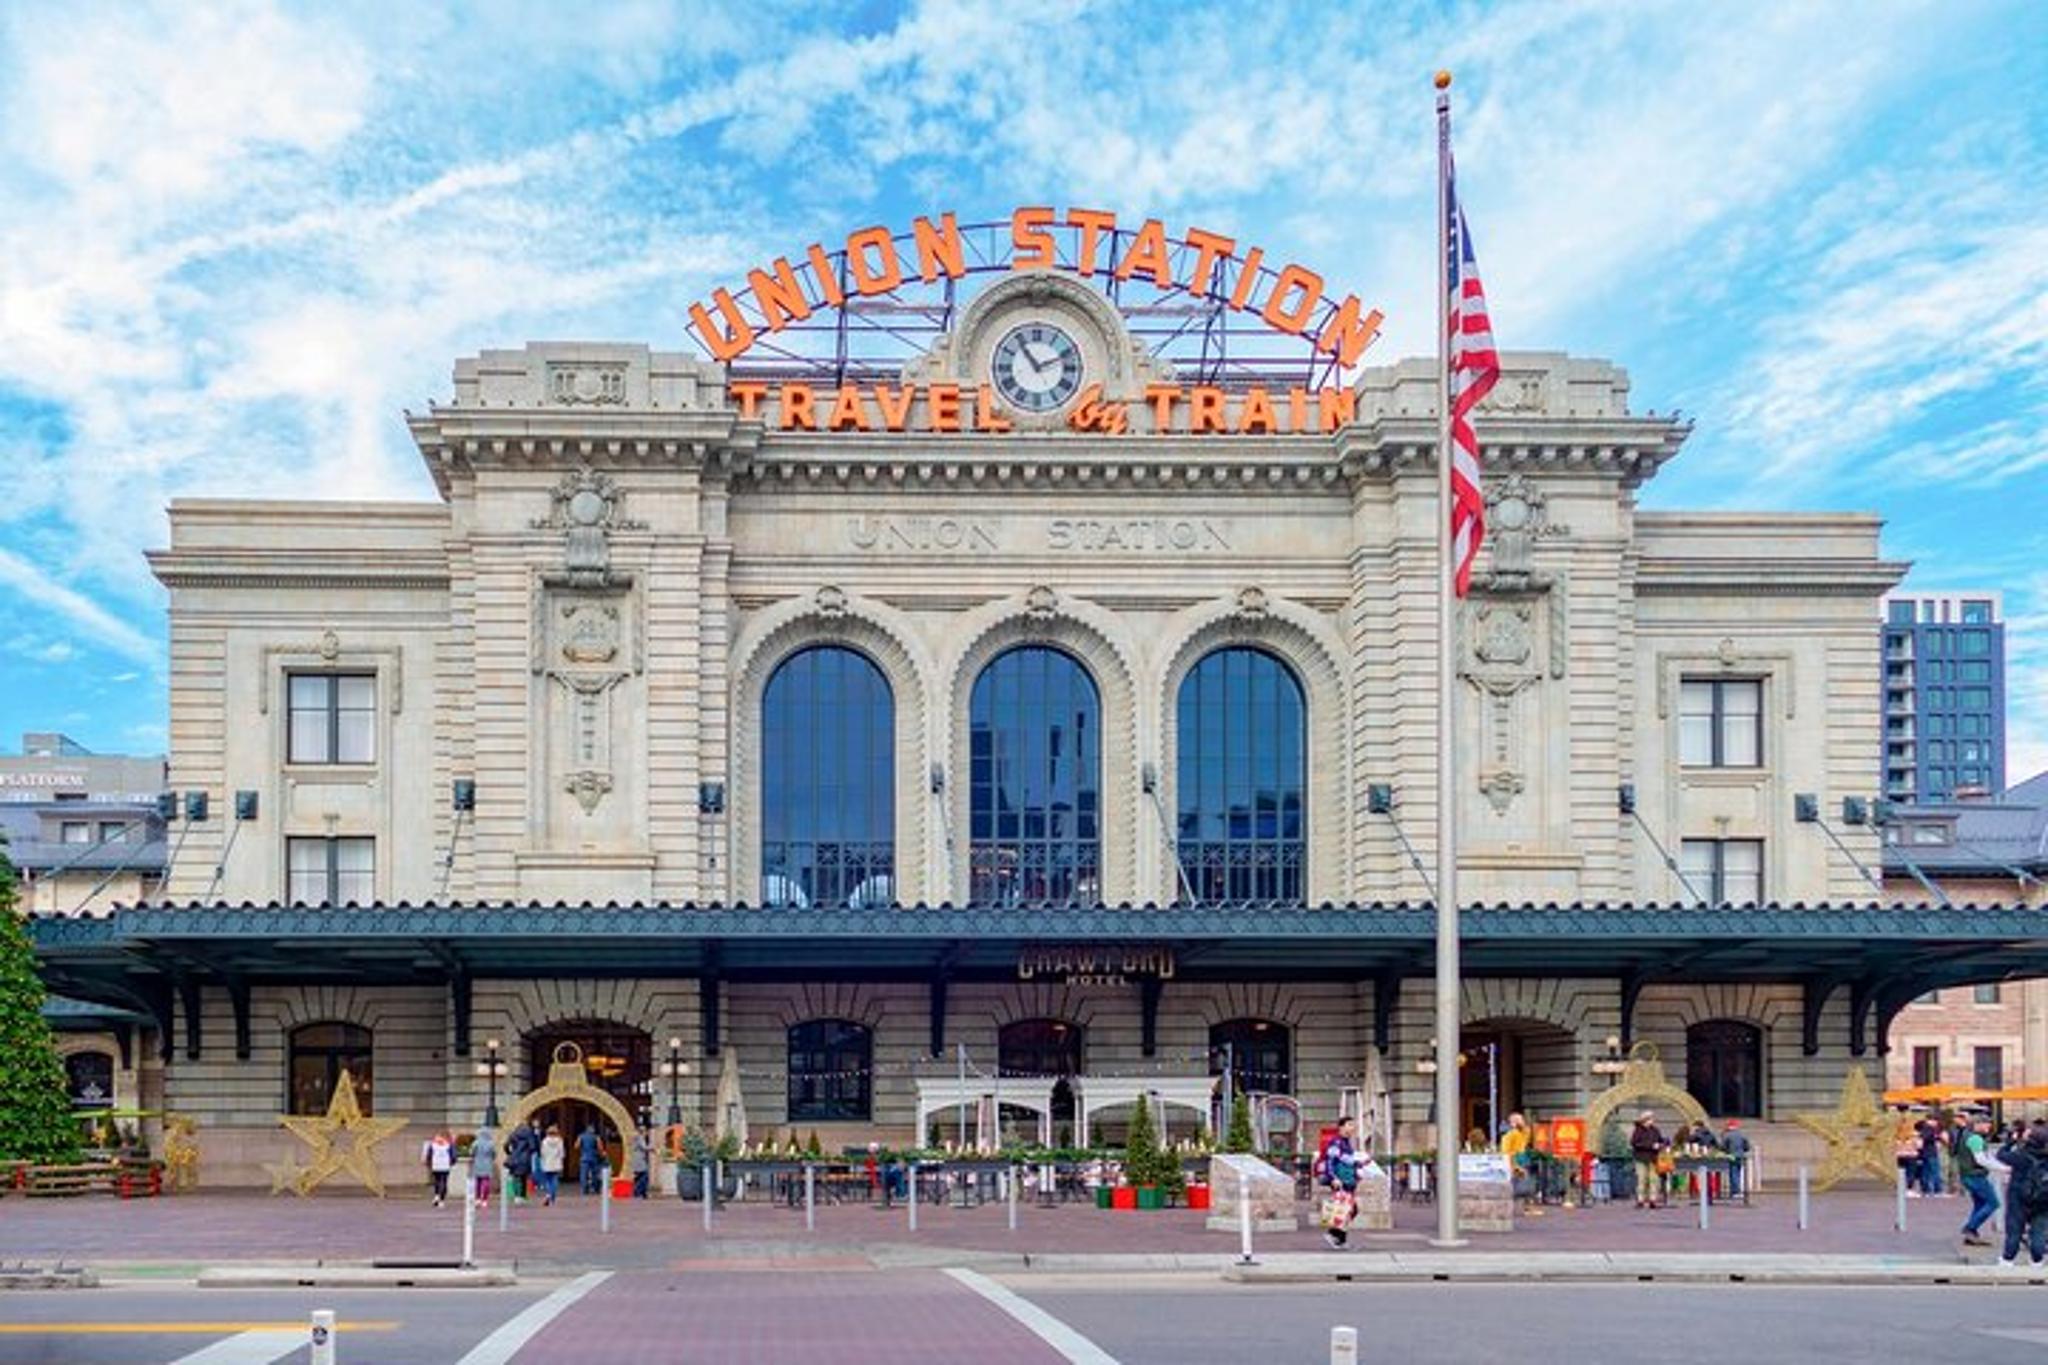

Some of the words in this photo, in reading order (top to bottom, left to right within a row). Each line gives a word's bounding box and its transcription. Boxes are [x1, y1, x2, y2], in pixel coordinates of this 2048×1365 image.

[689, 212, 966, 362] UNION
[1011, 206, 1384, 370] STATION
[729, 380, 1013, 432] TRAVEL
[1066, 383, 1128, 434] by
[1145, 385, 1356, 434] TRAIN
[848, 519, 1000, 550] UNION
[1047, 519, 1233, 551] STATION
[1066, 975, 1126, 987] HOTEL
